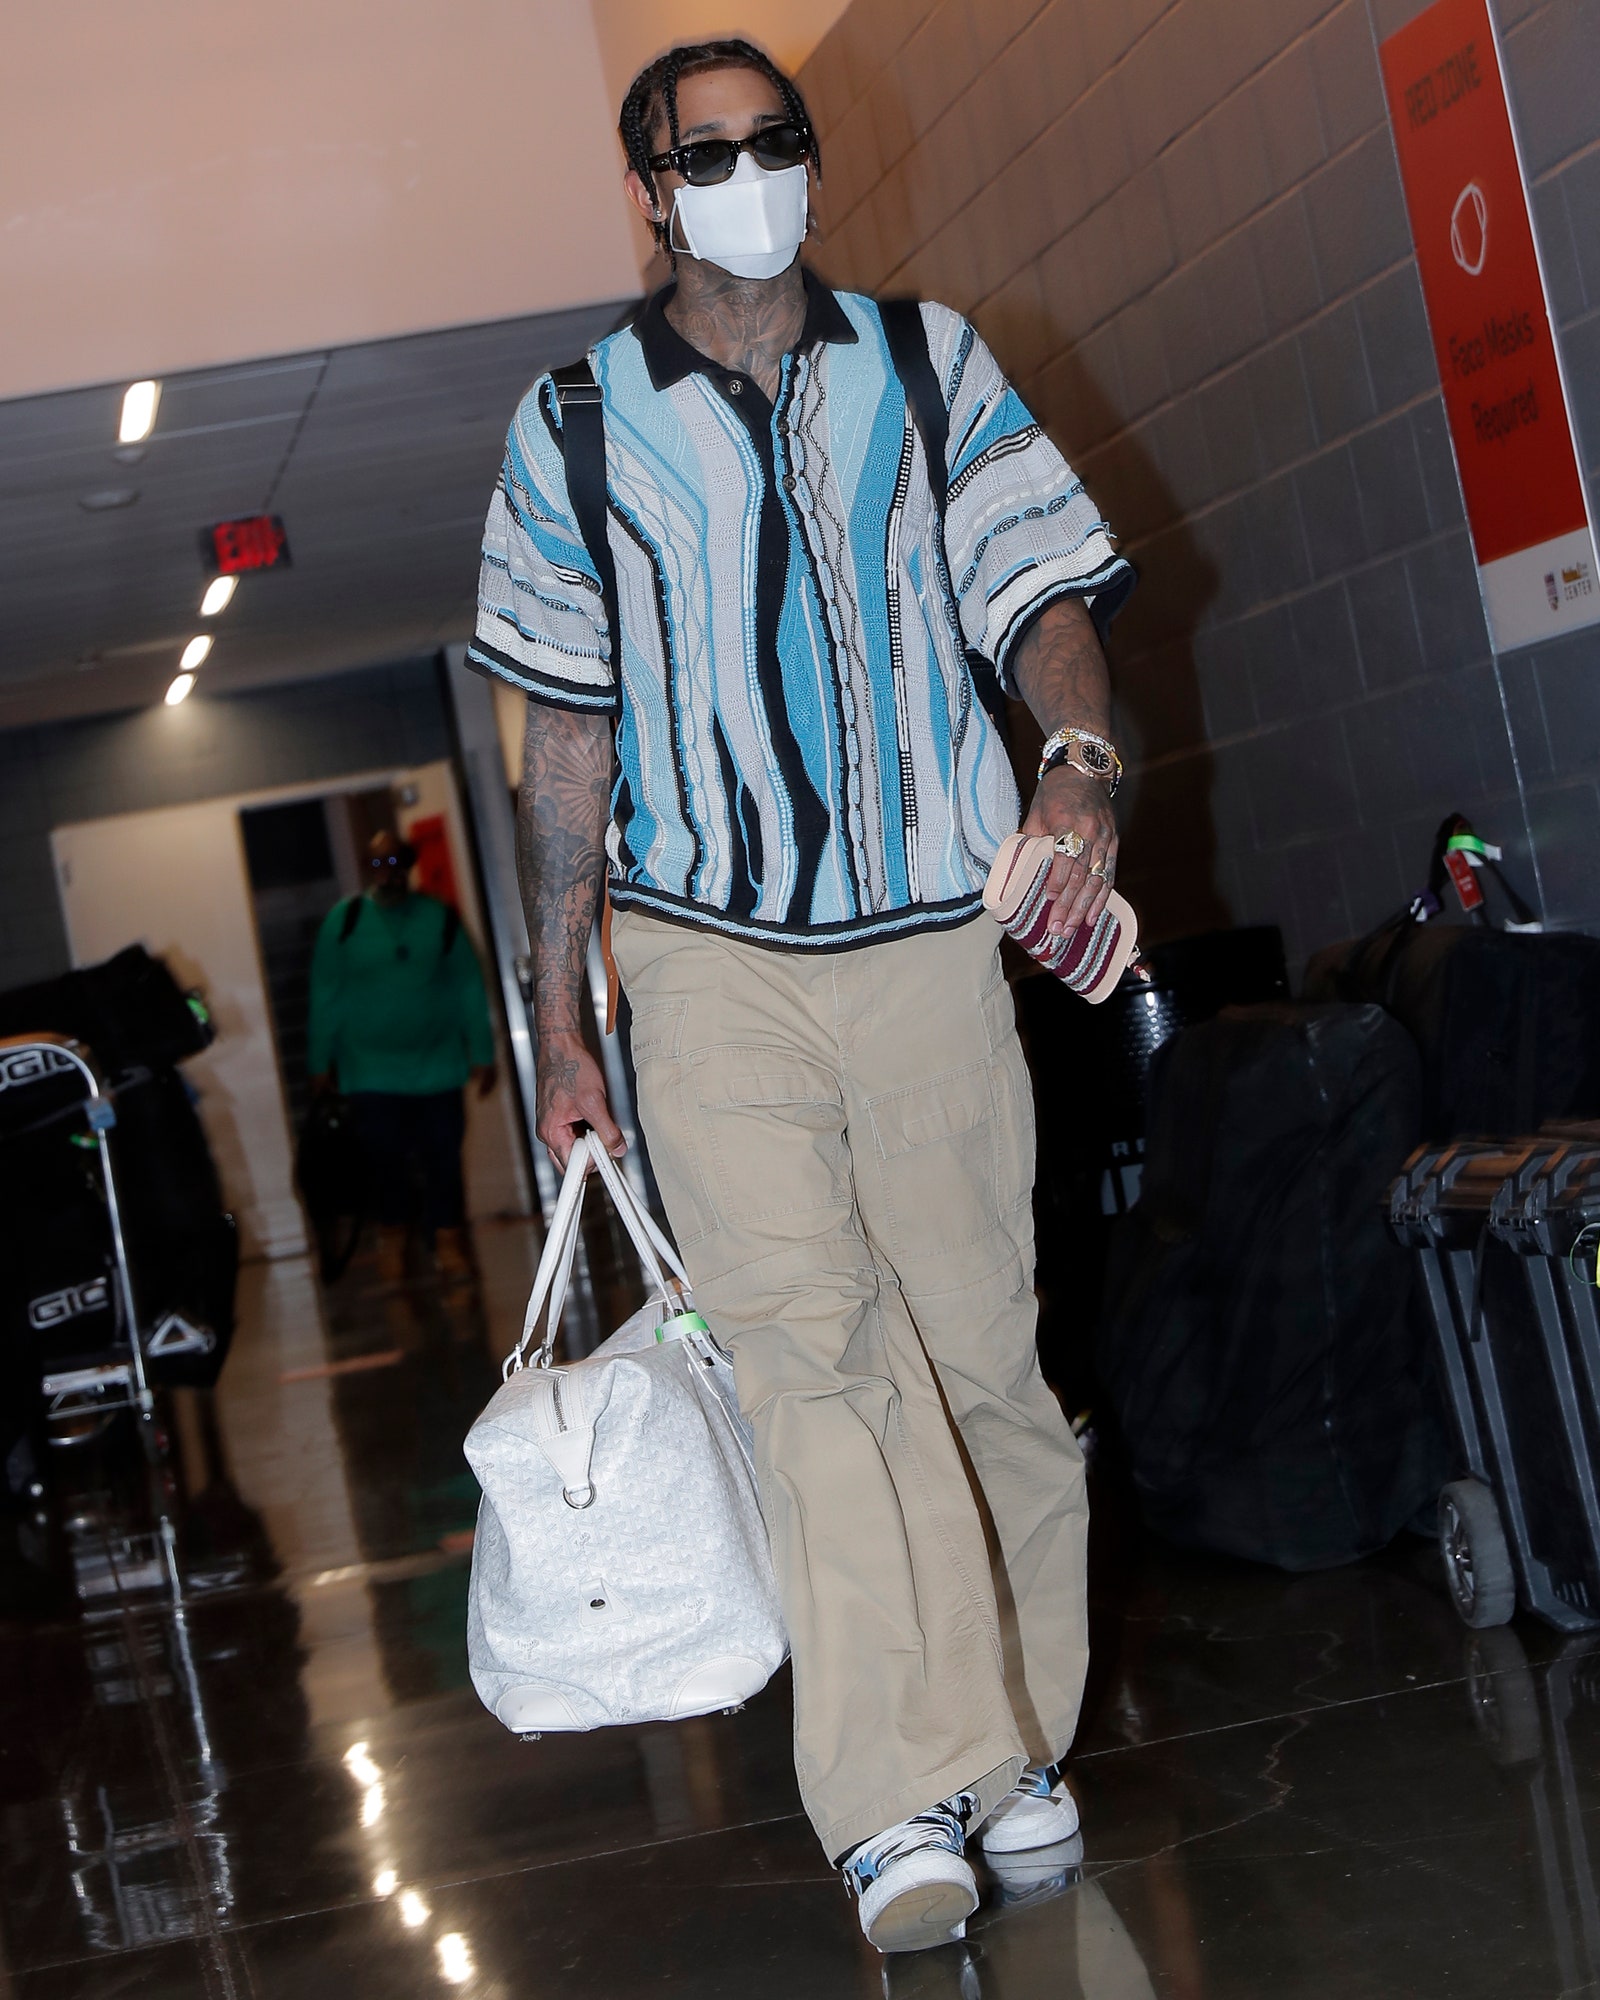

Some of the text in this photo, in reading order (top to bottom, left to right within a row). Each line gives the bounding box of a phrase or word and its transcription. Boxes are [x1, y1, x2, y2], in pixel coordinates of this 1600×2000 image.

[1449, 309, 1534, 378] Face Masks
[1471, 376, 1539, 446] Required
